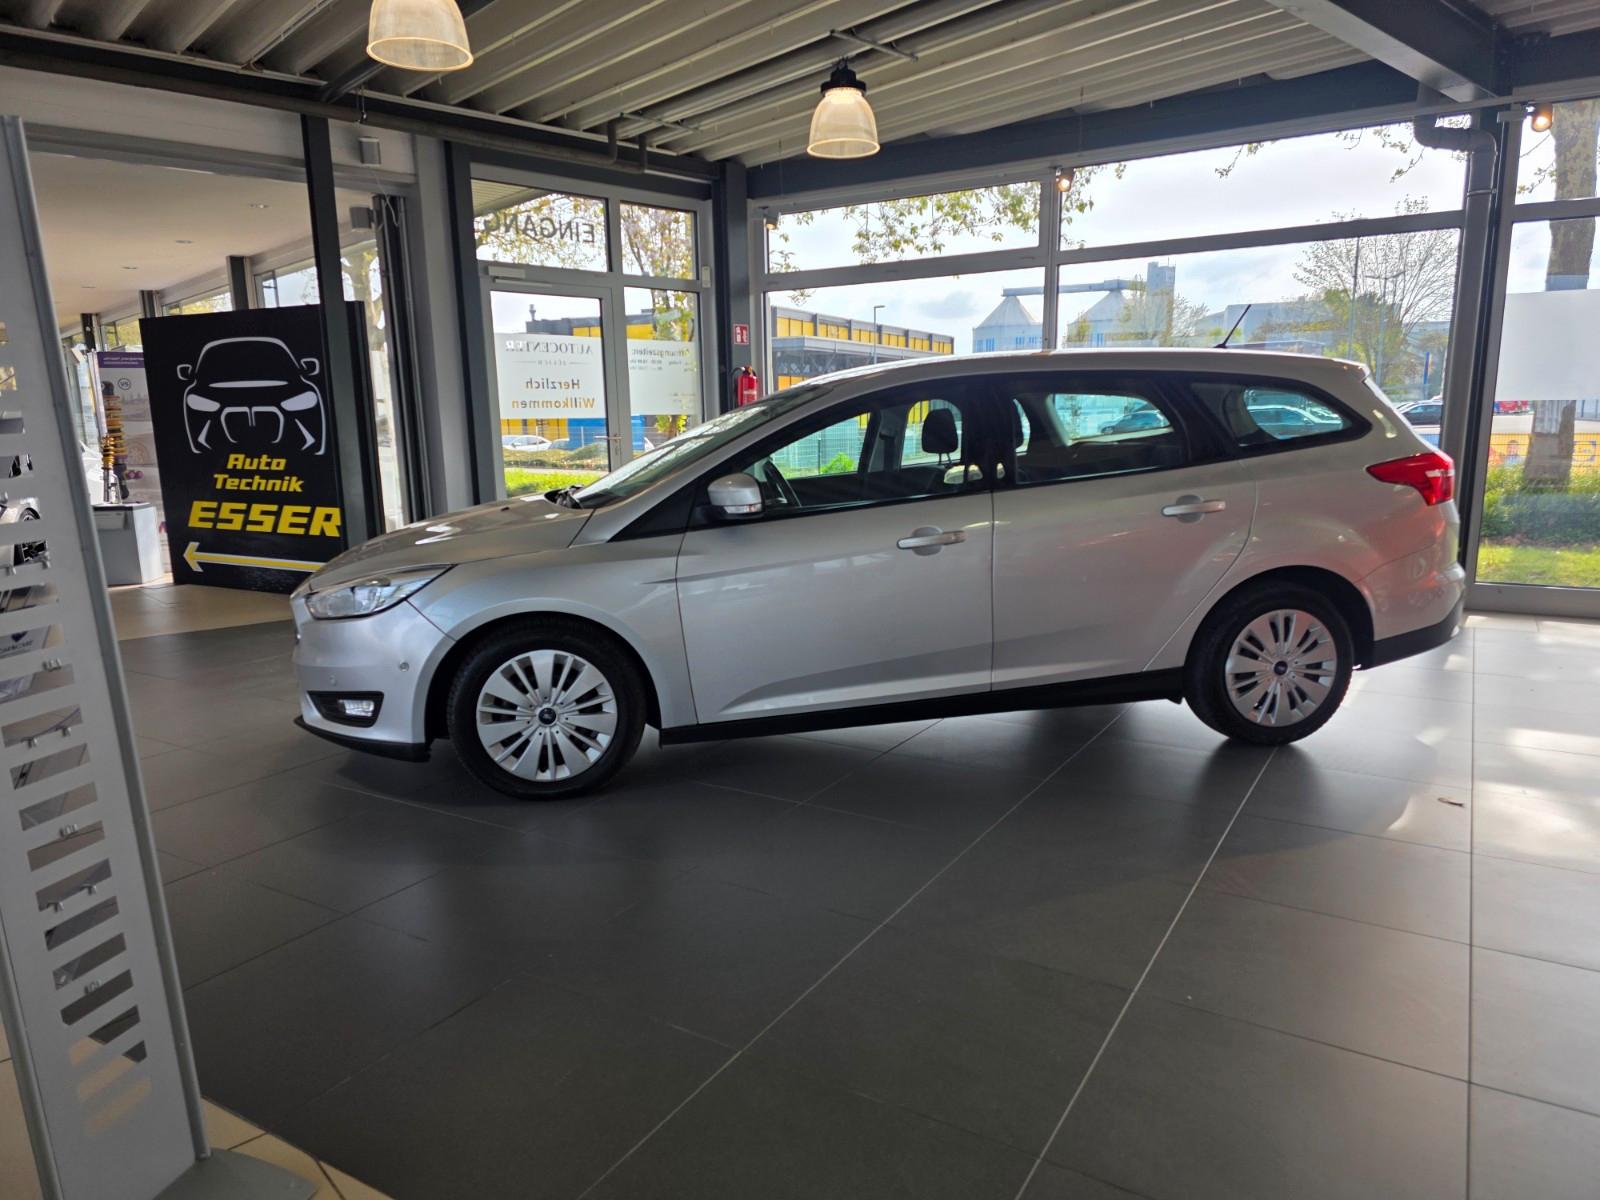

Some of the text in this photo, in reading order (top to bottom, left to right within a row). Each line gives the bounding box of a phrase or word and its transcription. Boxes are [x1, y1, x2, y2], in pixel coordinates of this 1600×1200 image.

[227, 453, 287, 471] Auto
[213, 473, 305, 493] Technik
[188, 500, 342, 538] ESSER
